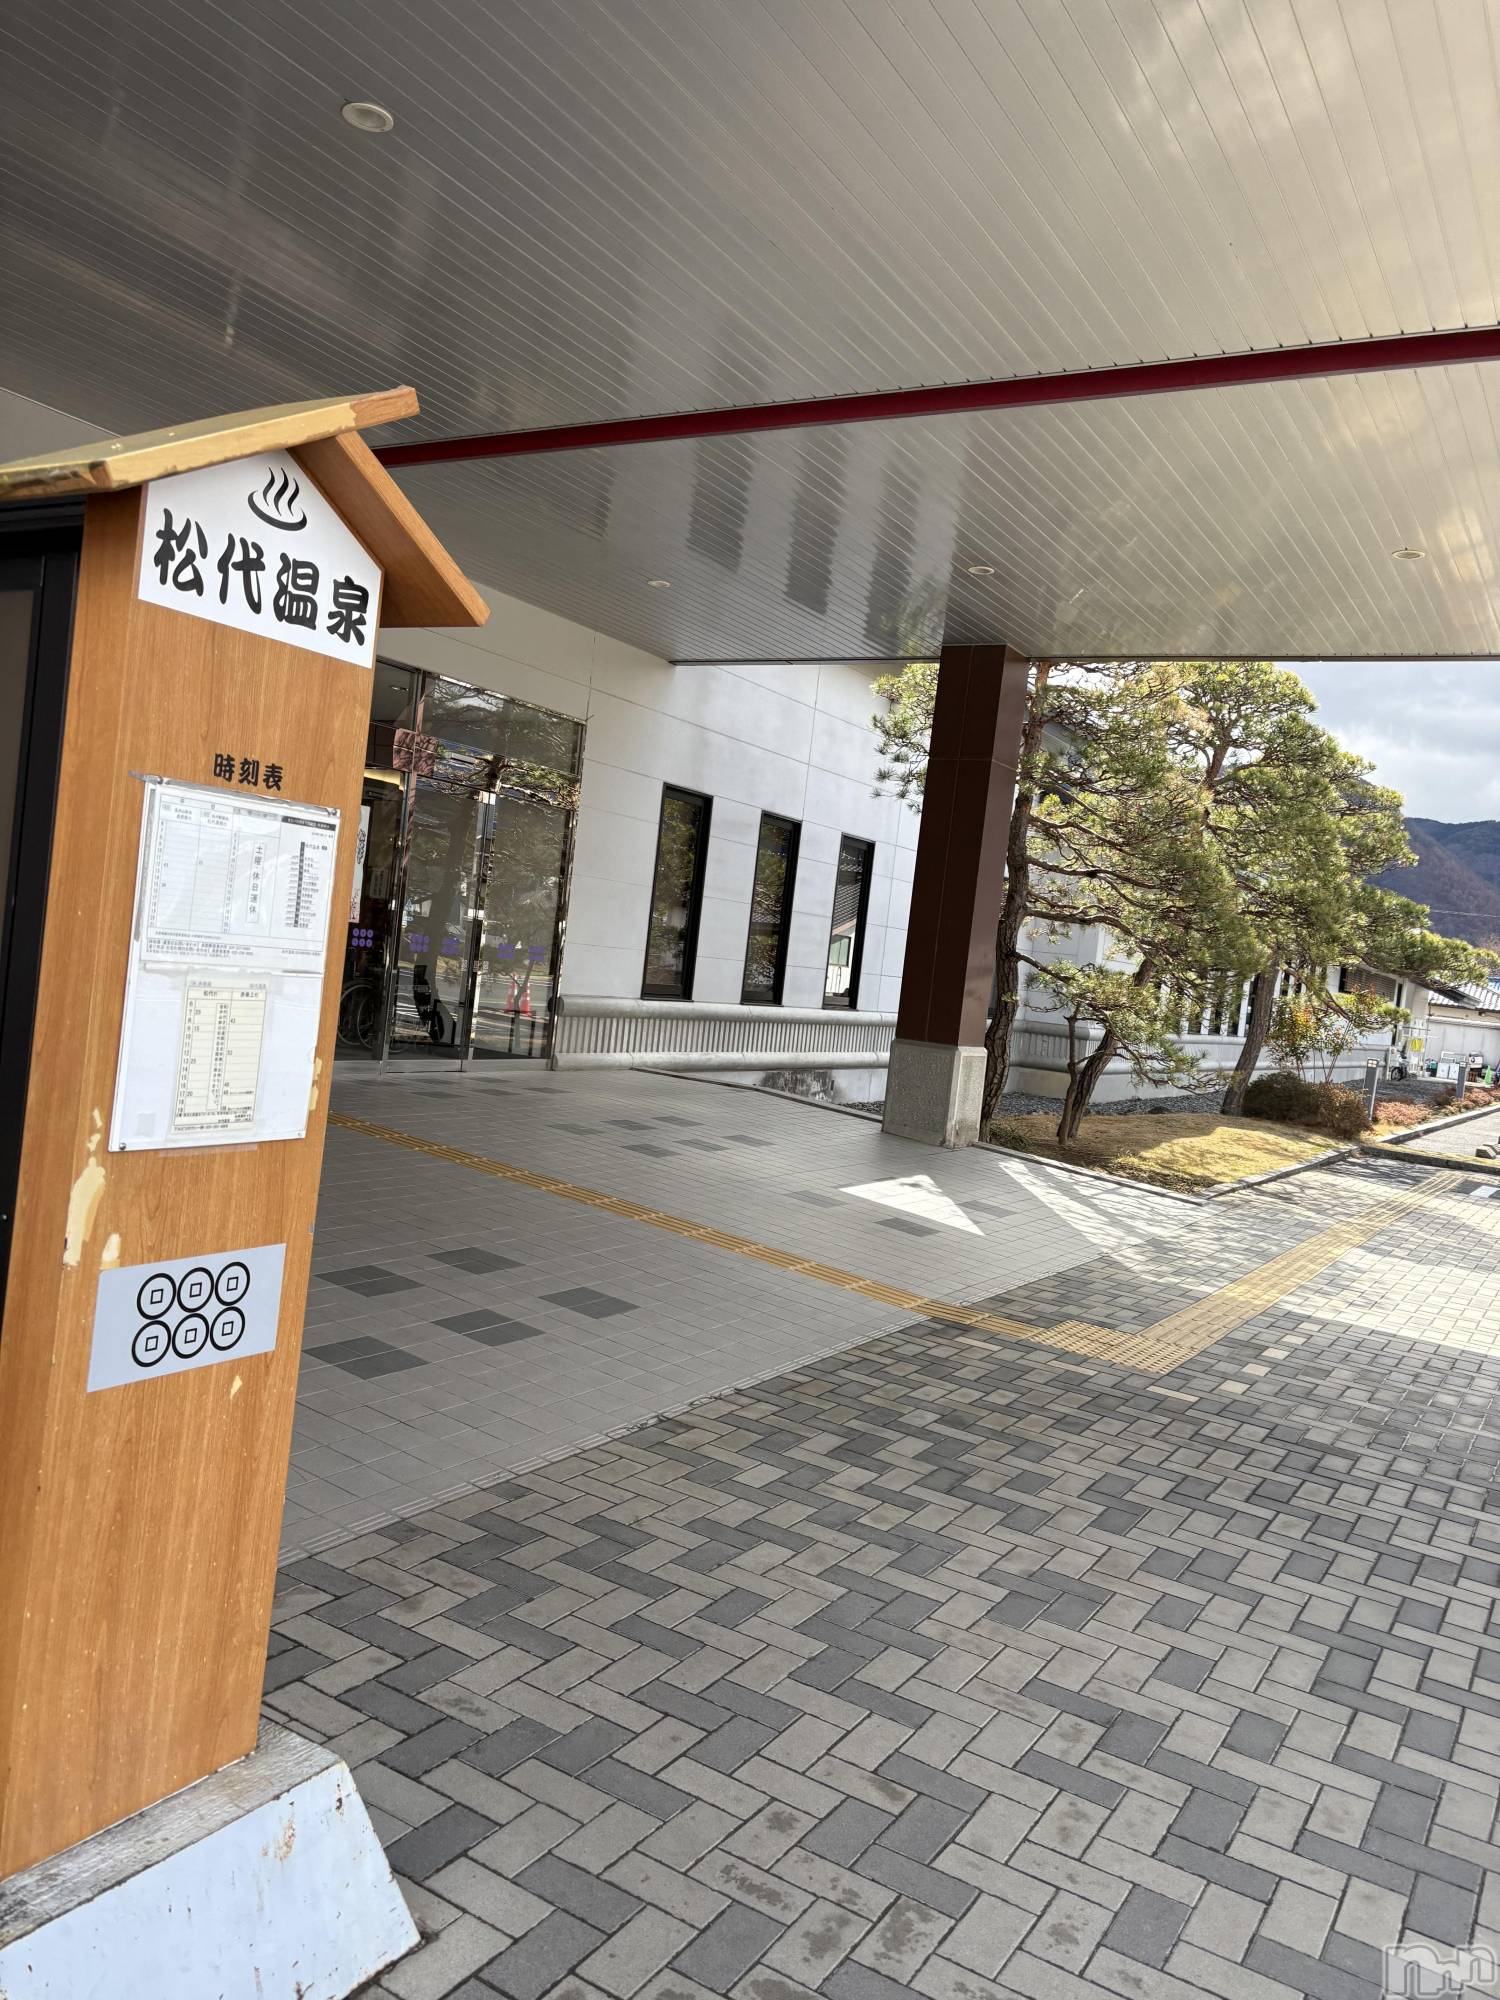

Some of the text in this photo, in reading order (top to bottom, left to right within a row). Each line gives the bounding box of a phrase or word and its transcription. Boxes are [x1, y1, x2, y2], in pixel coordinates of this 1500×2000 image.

[154, 508, 369, 646] 松代温泉
[213, 753, 283, 791] 時刻表
[249, 845, 263, 915] 土曜・休日運休
